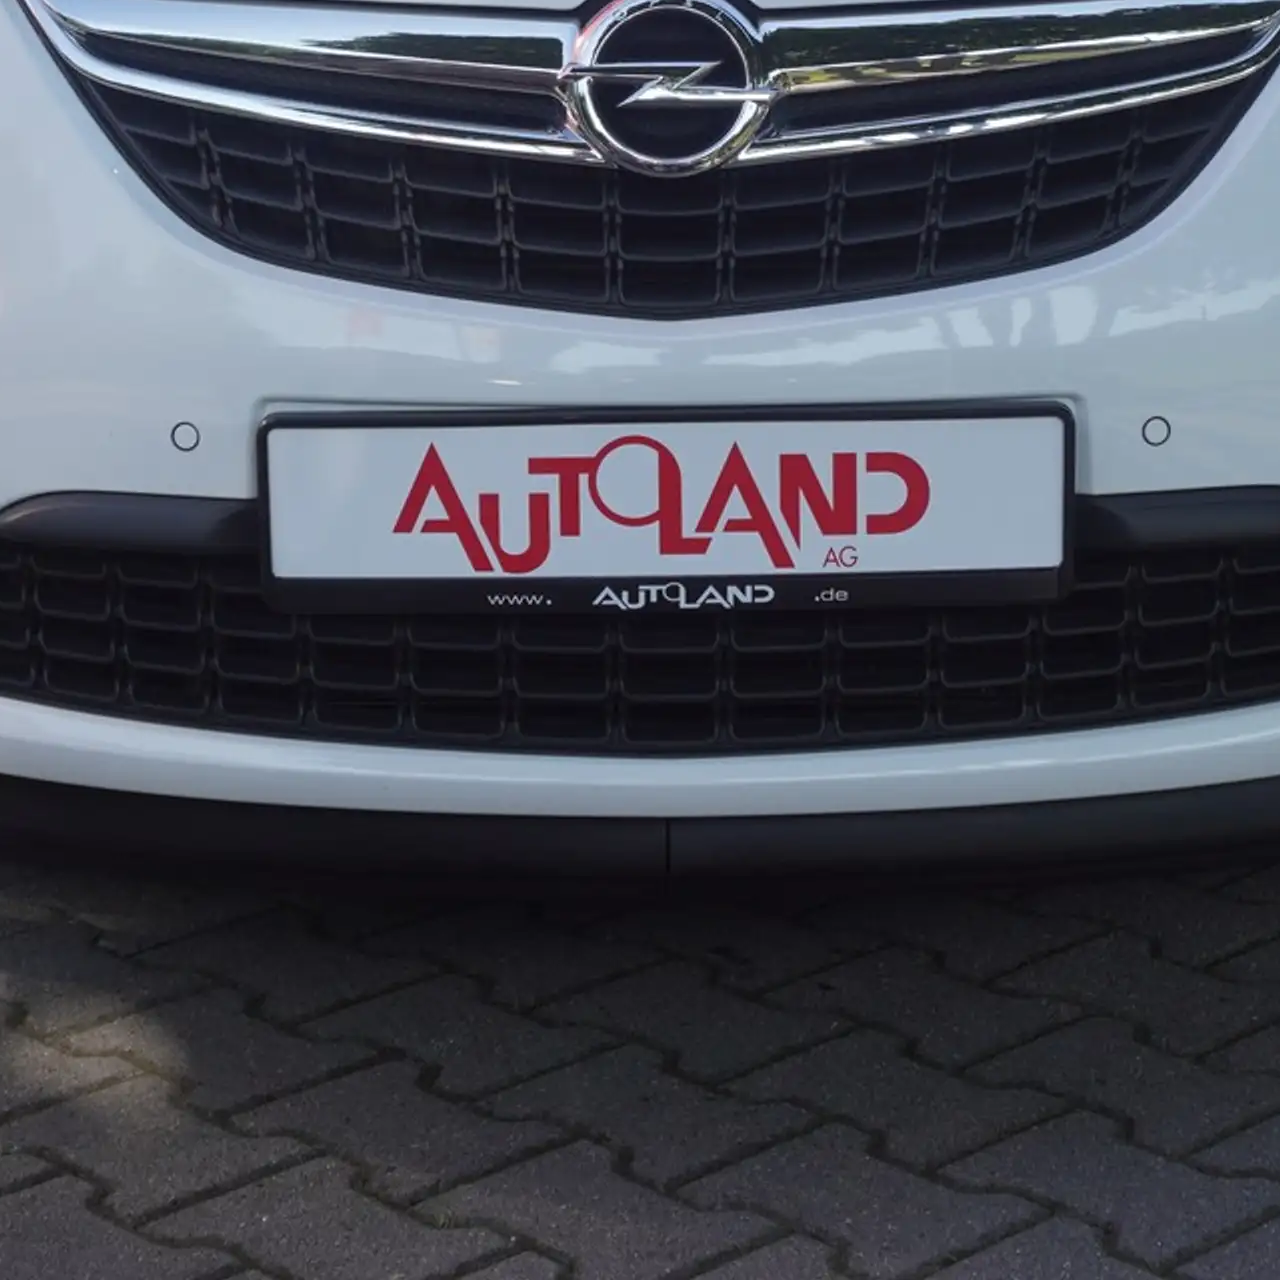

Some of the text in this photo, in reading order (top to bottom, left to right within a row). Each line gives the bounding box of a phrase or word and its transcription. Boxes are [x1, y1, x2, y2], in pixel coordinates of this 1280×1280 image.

[823, 546, 859, 568] AG
[487, 593, 552, 606] www.
[814, 588, 849, 602] .de
